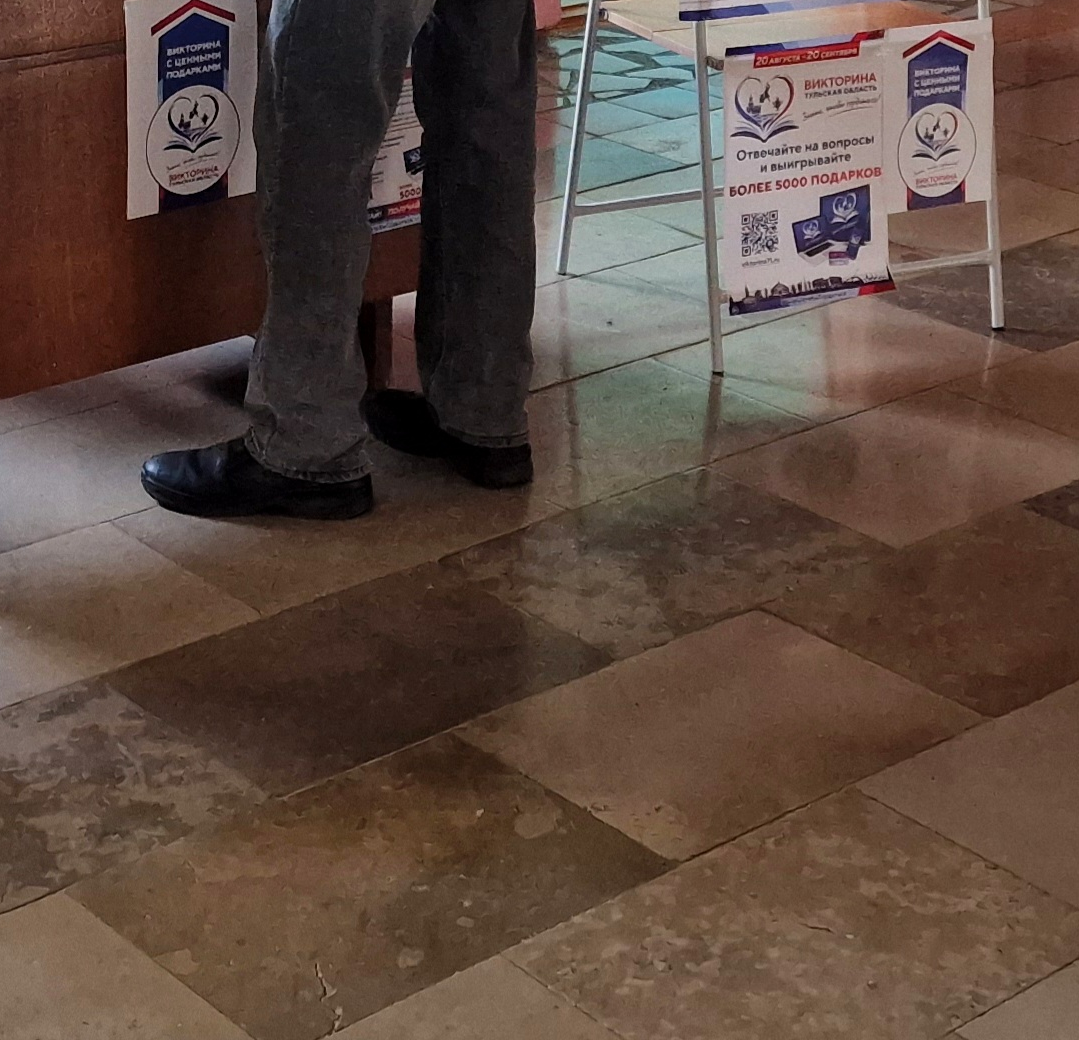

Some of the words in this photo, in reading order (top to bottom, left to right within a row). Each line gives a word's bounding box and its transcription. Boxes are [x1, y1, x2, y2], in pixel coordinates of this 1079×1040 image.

[166, 40, 221, 57] ВИКТОРИНА
[755, 55, 769, 66] 20
[769, 55, 801, 64] АВГУСТА
[806, 50, 819, 61] 20
[820, 48, 858, 60] СЕНТЯБРЯ
[166, 59, 173, 68] С
[174, 51, 222, 68] ЦЕННЫМИ
[165, 63, 221, 80] ПОДАРКАМИ
[914, 65, 961, 78] ВИКТОРИНА
[804, 72, 877, 91] ВИКТОРИНА
[913, 79, 920, 87] С
[920, 74, 961, 86] ЦЕННЫМИ
[804, 89, 843, 99] ТУЛЬСКАЯ
[843, 85, 877, 95] ОБЛАСТЬ
[913, 85, 961, 98] ПОДАРКАМИ
[736, 143, 802, 161] Отвечайте
[805, 142, 819, 152] на
[822, 135, 875, 150] вопросы
[760, 164, 768, 173] и
[770, 151, 852, 173] выигрывайте
[729, 181, 772, 197] БОЛЕЕ
[775, 176, 808, 191] 5000
[811, 166, 883, 186] ПОДАРКОВ
[399, 186, 422, 199] 5000
